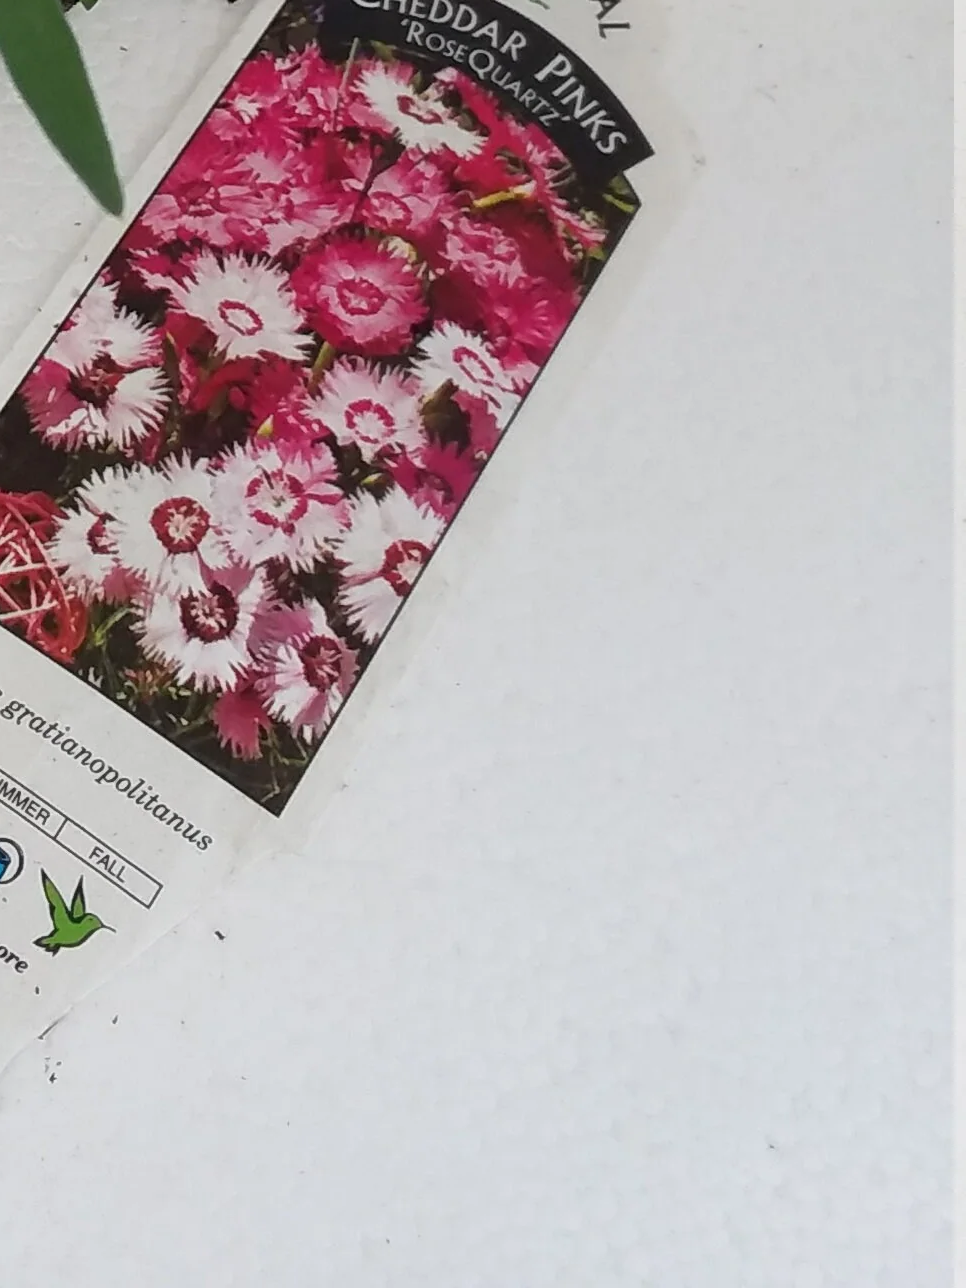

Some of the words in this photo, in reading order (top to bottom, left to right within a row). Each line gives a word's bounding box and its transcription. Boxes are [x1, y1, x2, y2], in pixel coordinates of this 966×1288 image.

[535, 53, 627, 155] PINKS
[0, 700, 213, 851] gratianopolitanus
[89, 847, 126, 883] FALL
